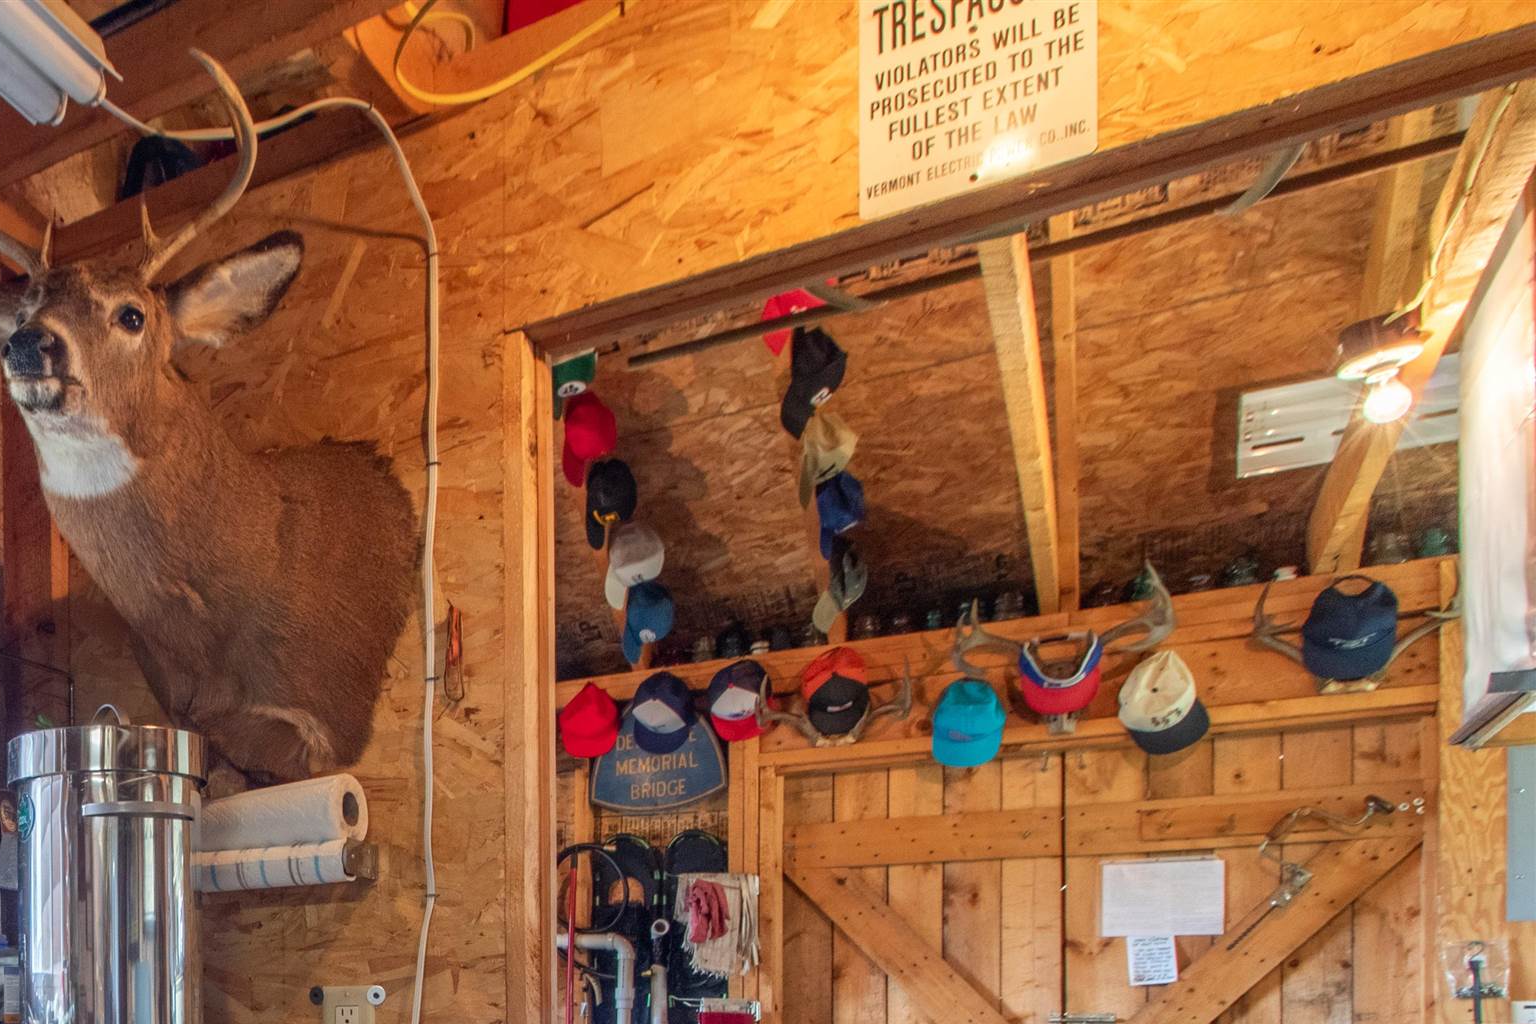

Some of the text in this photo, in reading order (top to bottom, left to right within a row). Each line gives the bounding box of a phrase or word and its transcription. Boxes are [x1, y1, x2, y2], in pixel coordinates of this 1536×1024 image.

[870, 30, 1085, 120] PROSECUTED TO THE
[875, 2, 1080, 91] VIOLATORS WILL BE
[888, 66, 1064, 141] FULLEST EXTENT
[911, 103, 1038, 161] OF THE LAW
[866, 171, 921, 200] VERMONT
[616, 752, 699, 776] MEMORIAL
[630, 779, 686, 800] BRIDGE
